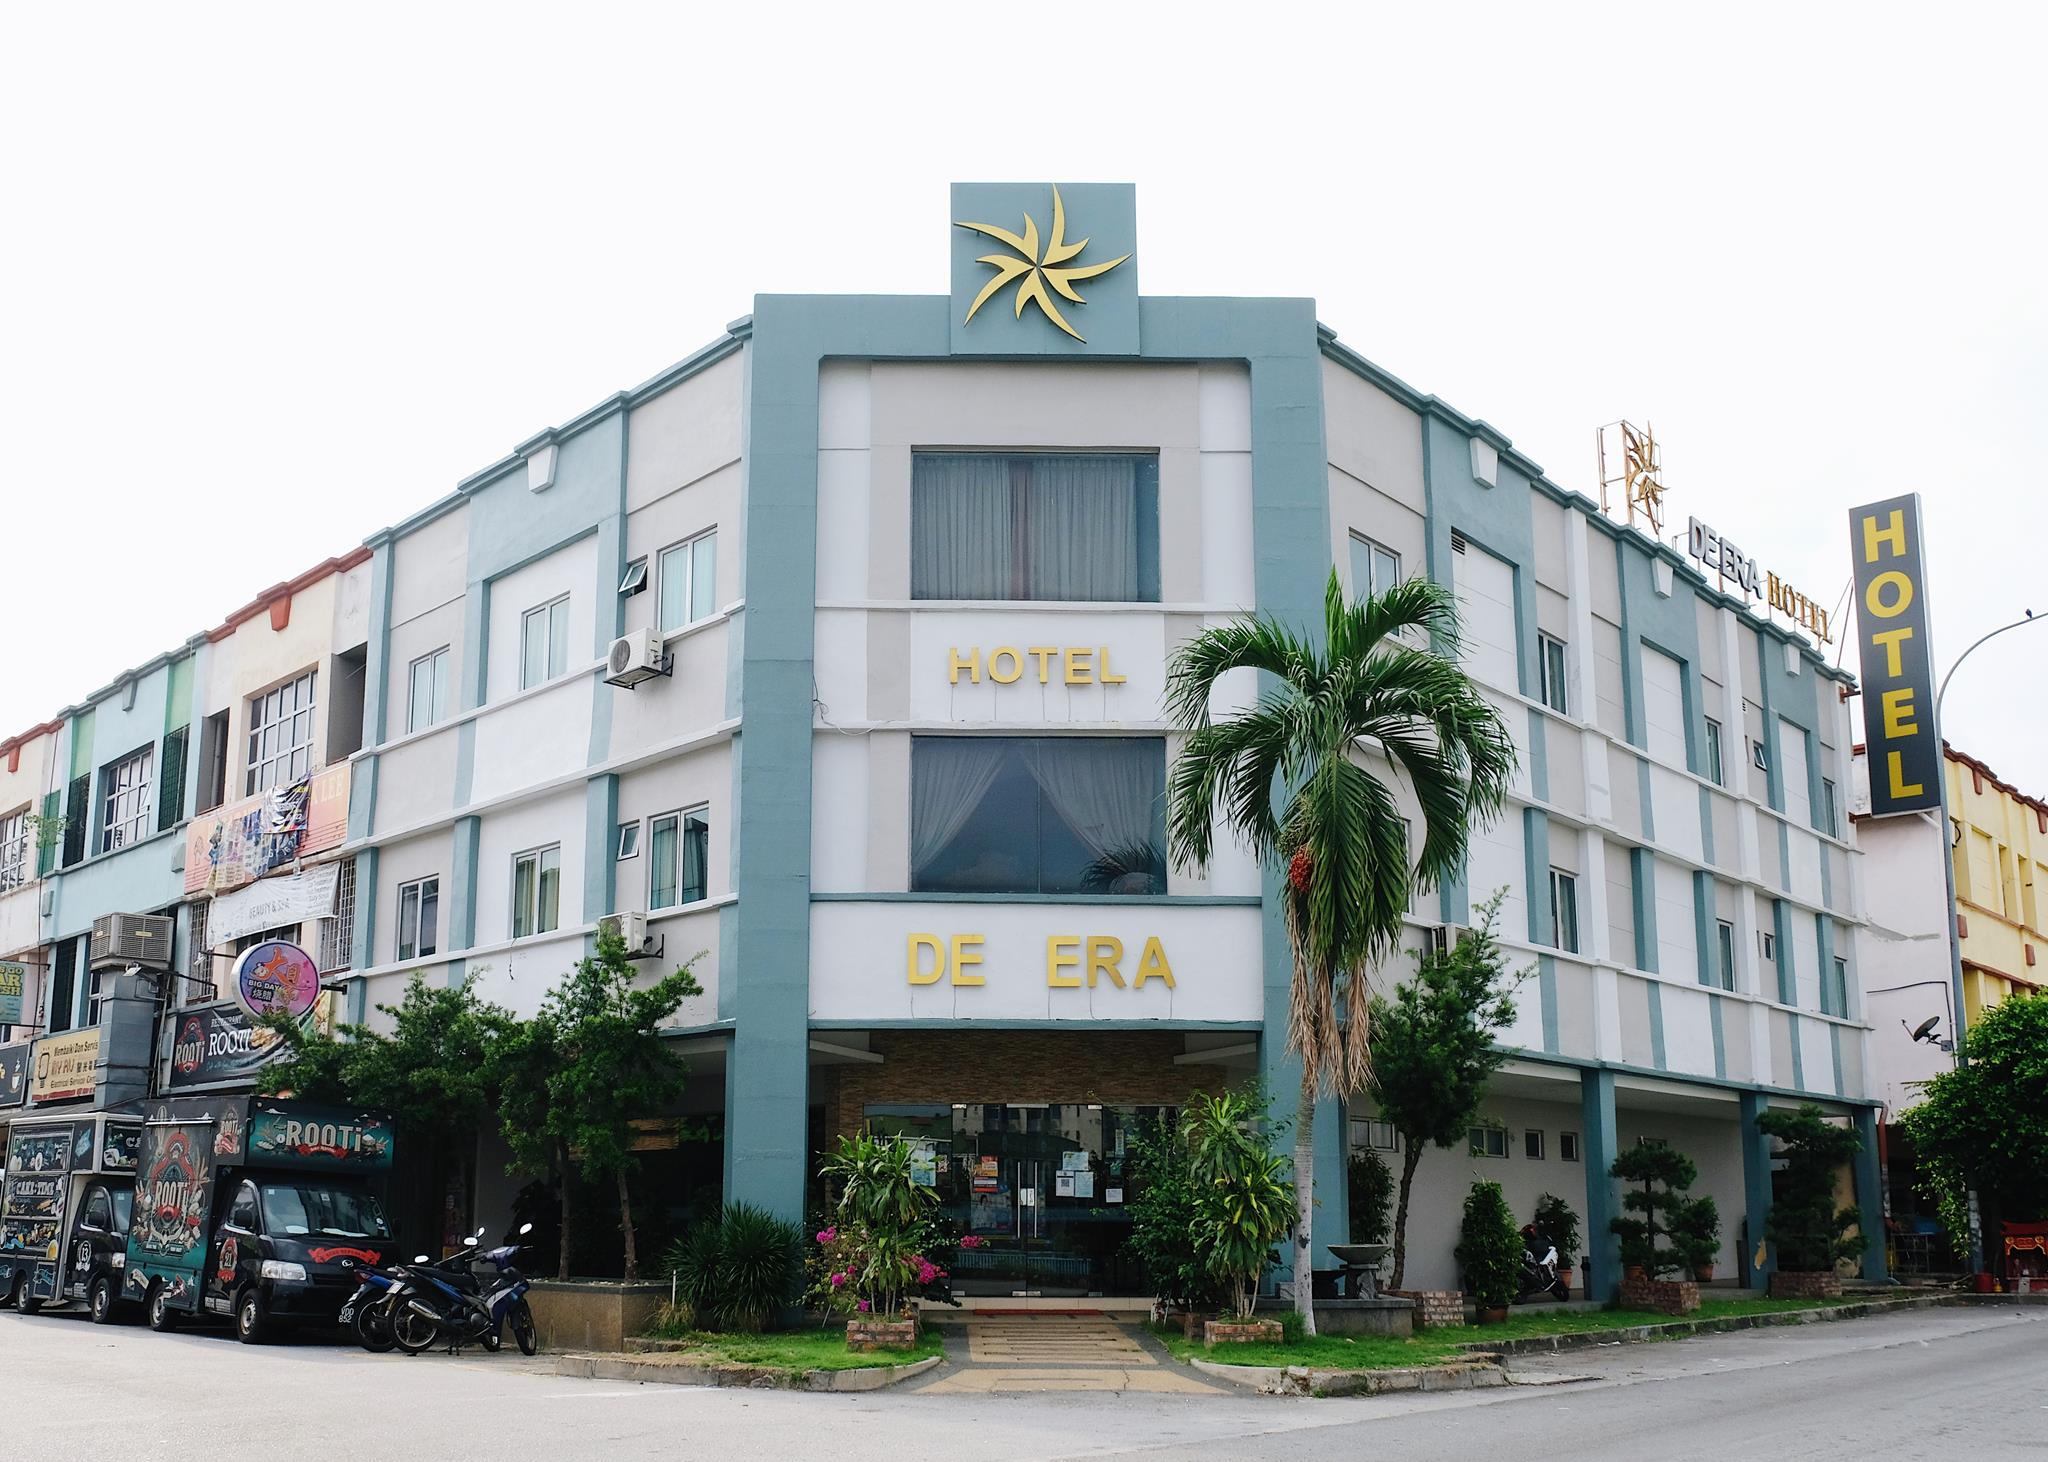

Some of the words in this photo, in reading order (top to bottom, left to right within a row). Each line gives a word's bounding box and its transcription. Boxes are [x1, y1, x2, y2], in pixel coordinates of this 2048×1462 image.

[1689, 515, 1719, 569] DE
[1720, 536, 1763, 600] ERA
[1766, 570, 1833, 645] HOTEL
[949, 646, 1128, 686] HOTEL
[1863, 509, 1924, 799] HOTEL
[247, 979, 262, 988] BIG
[907, 932, 986, 986] DE
[1046, 935, 1177, 989] ERA
